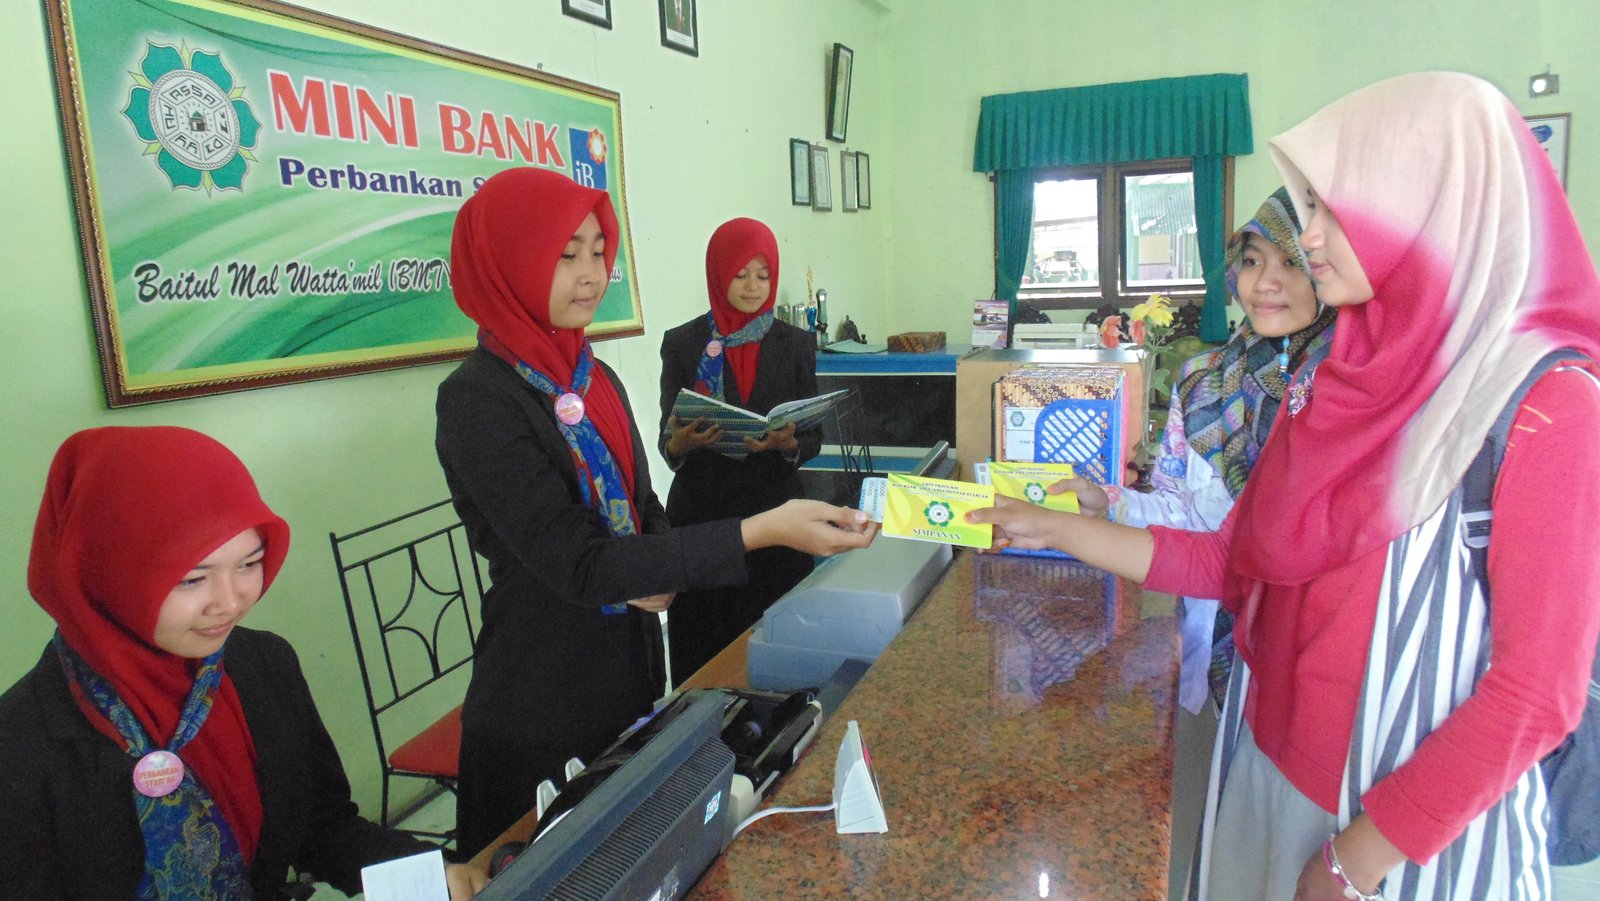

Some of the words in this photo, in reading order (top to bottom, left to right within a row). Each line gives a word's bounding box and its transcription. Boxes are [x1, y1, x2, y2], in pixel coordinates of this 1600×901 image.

[269, 71, 419, 148] MINI
[438, 103, 566, 168] BANK
[279, 157, 463, 198] Perbankan
[575, 160, 595, 189] iB
[134, 262, 220, 302] Baitul
[227, 261, 280, 299] Mal
[912, 527, 961, 541] SIMPANAN
